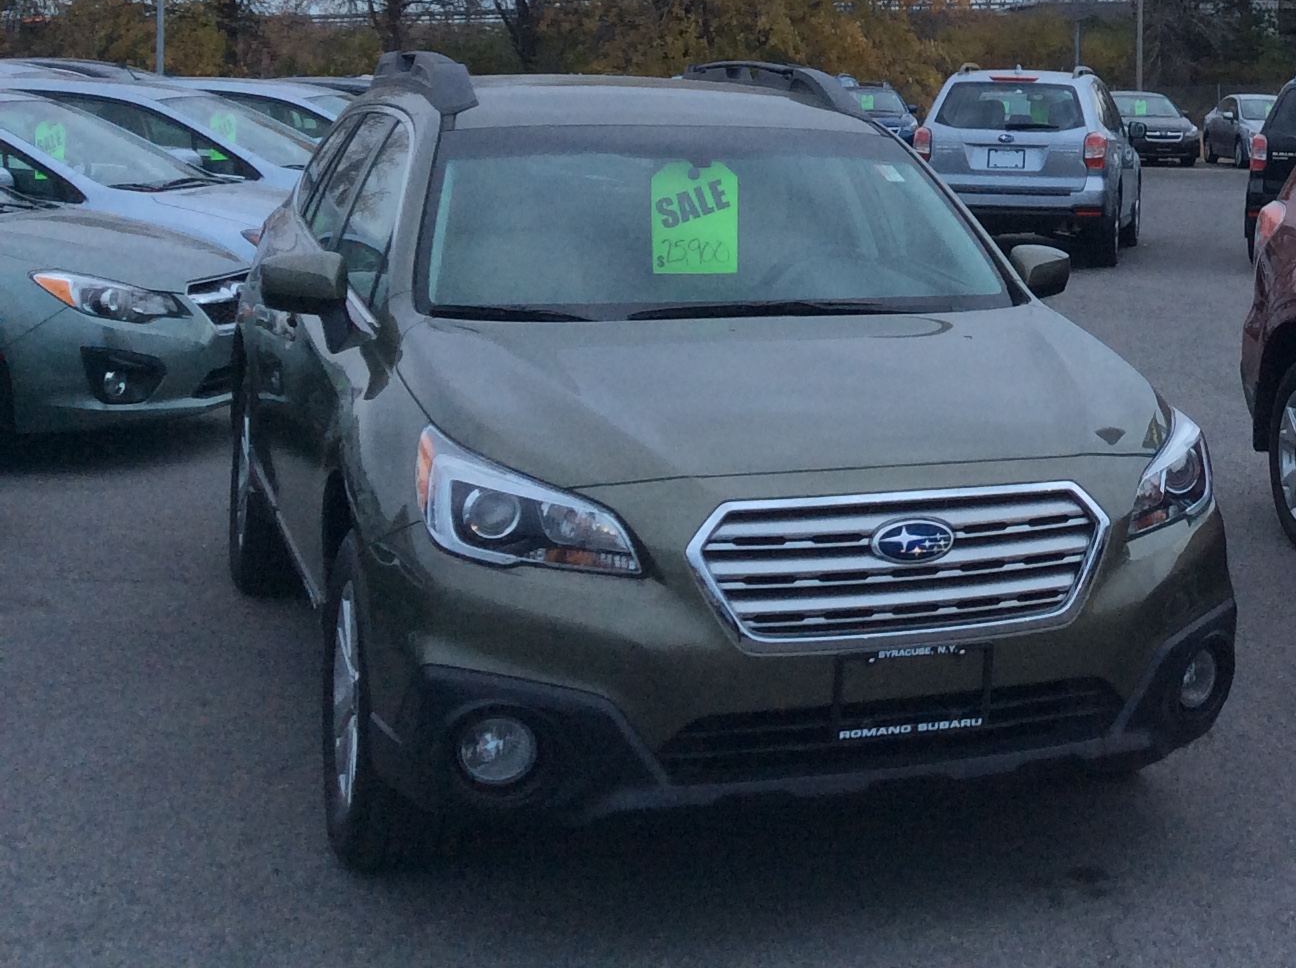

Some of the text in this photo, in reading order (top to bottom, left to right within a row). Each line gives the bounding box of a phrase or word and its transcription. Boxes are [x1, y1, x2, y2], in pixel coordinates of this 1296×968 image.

[655, 178, 731, 229] SALE
[838, 717, 983, 740] ROMANO SUBARU
